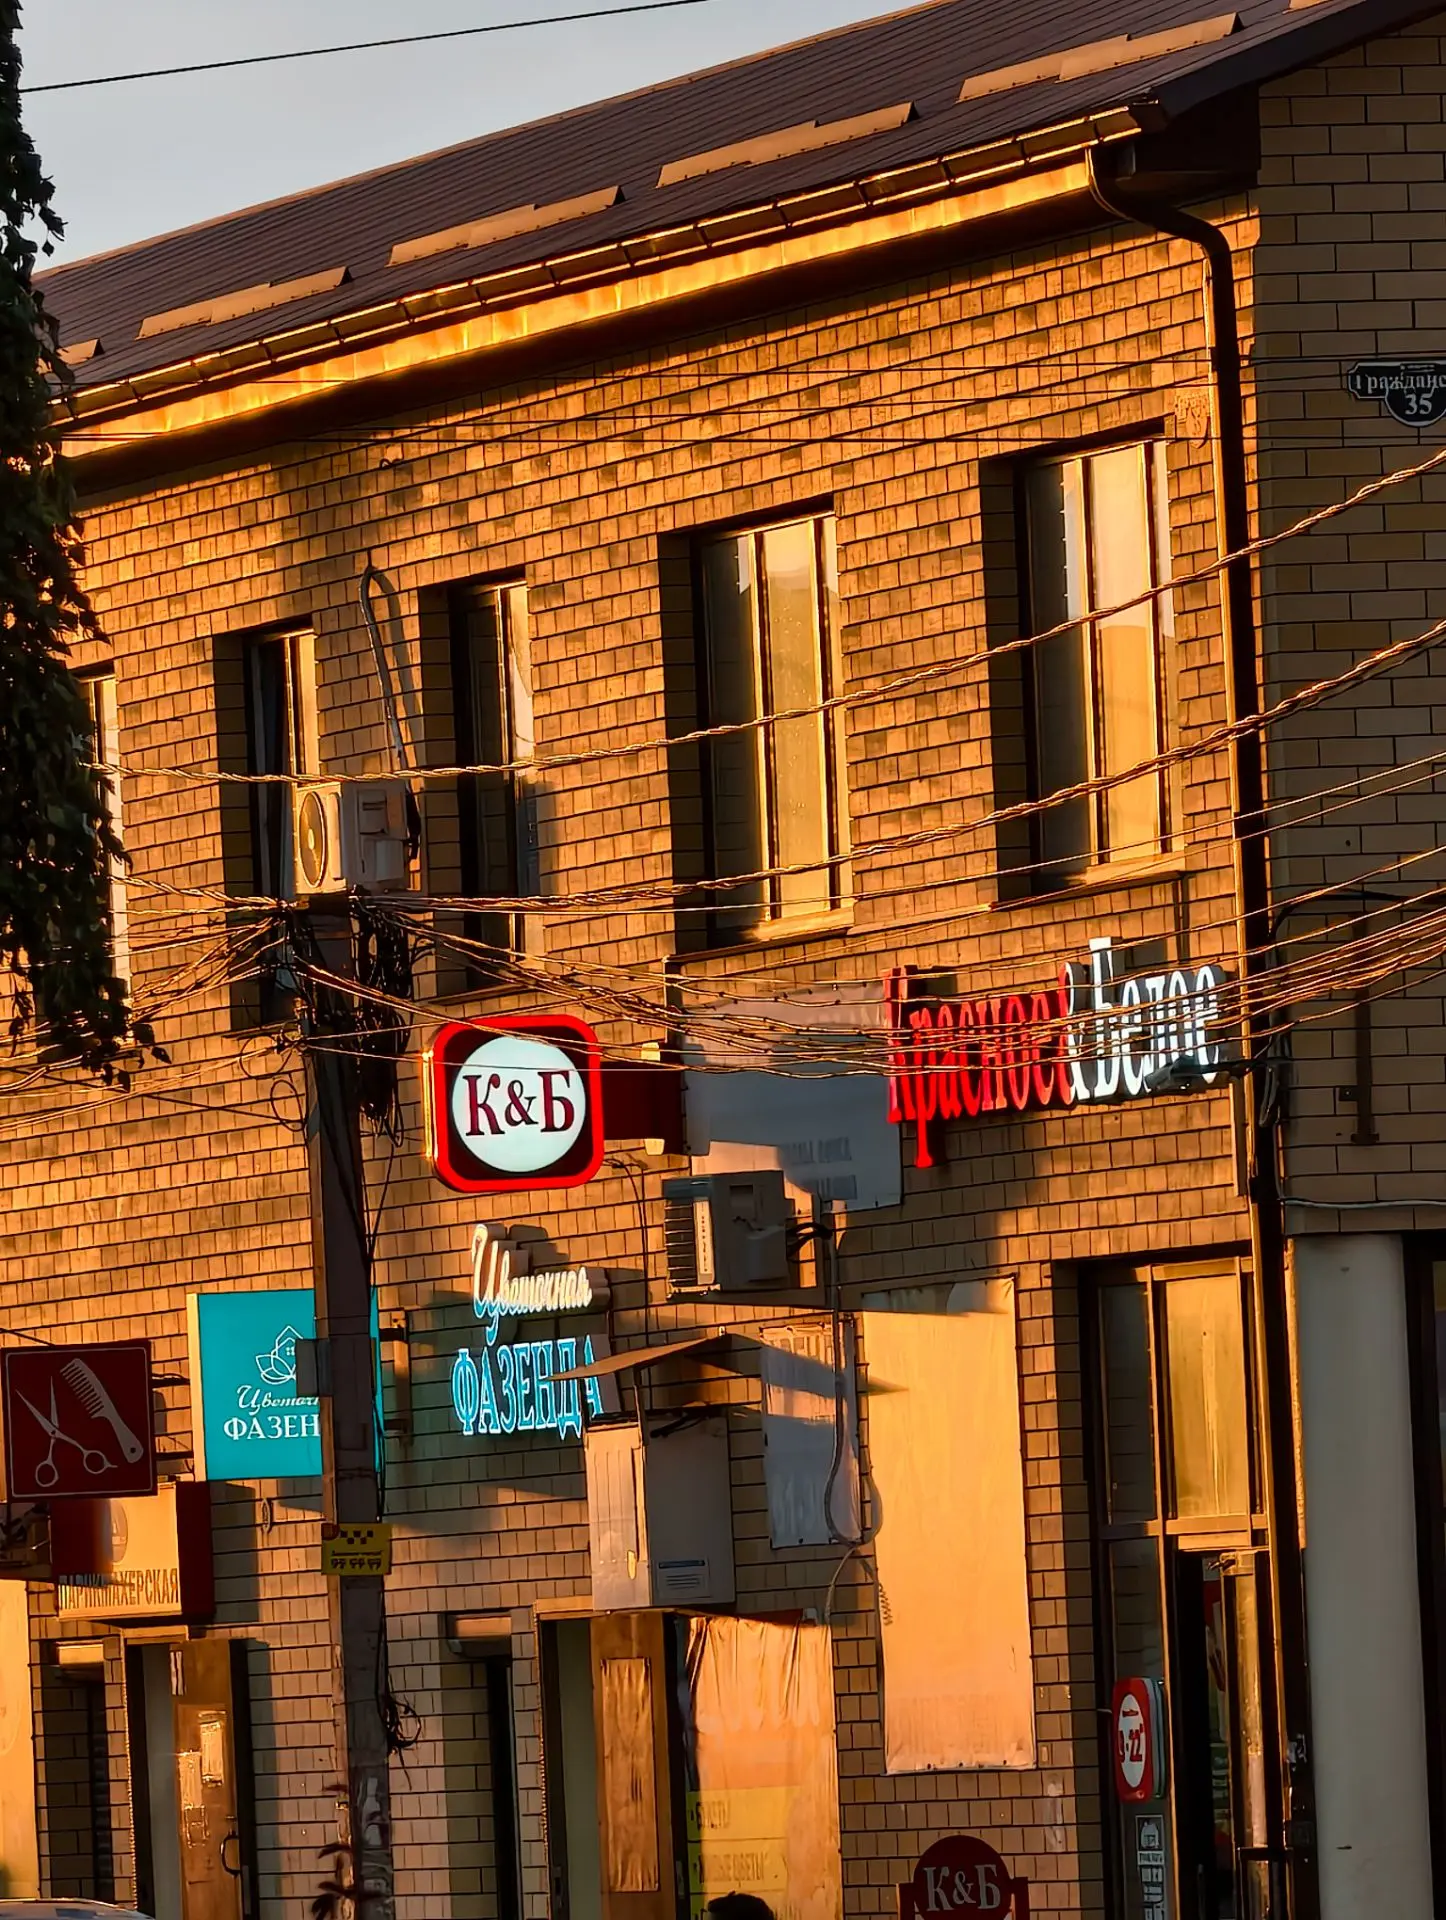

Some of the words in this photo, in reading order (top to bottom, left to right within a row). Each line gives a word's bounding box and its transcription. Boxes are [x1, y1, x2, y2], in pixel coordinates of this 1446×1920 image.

[1404, 393, 1432, 415] 35
[462, 1070, 576, 1136] К&Б
[452, 1334, 604, 1440] ФАЗЕНДА
[223, 1413, 320, 1440] ФАЗЕН
[922, 1863, 1001, 1912] К&Б
